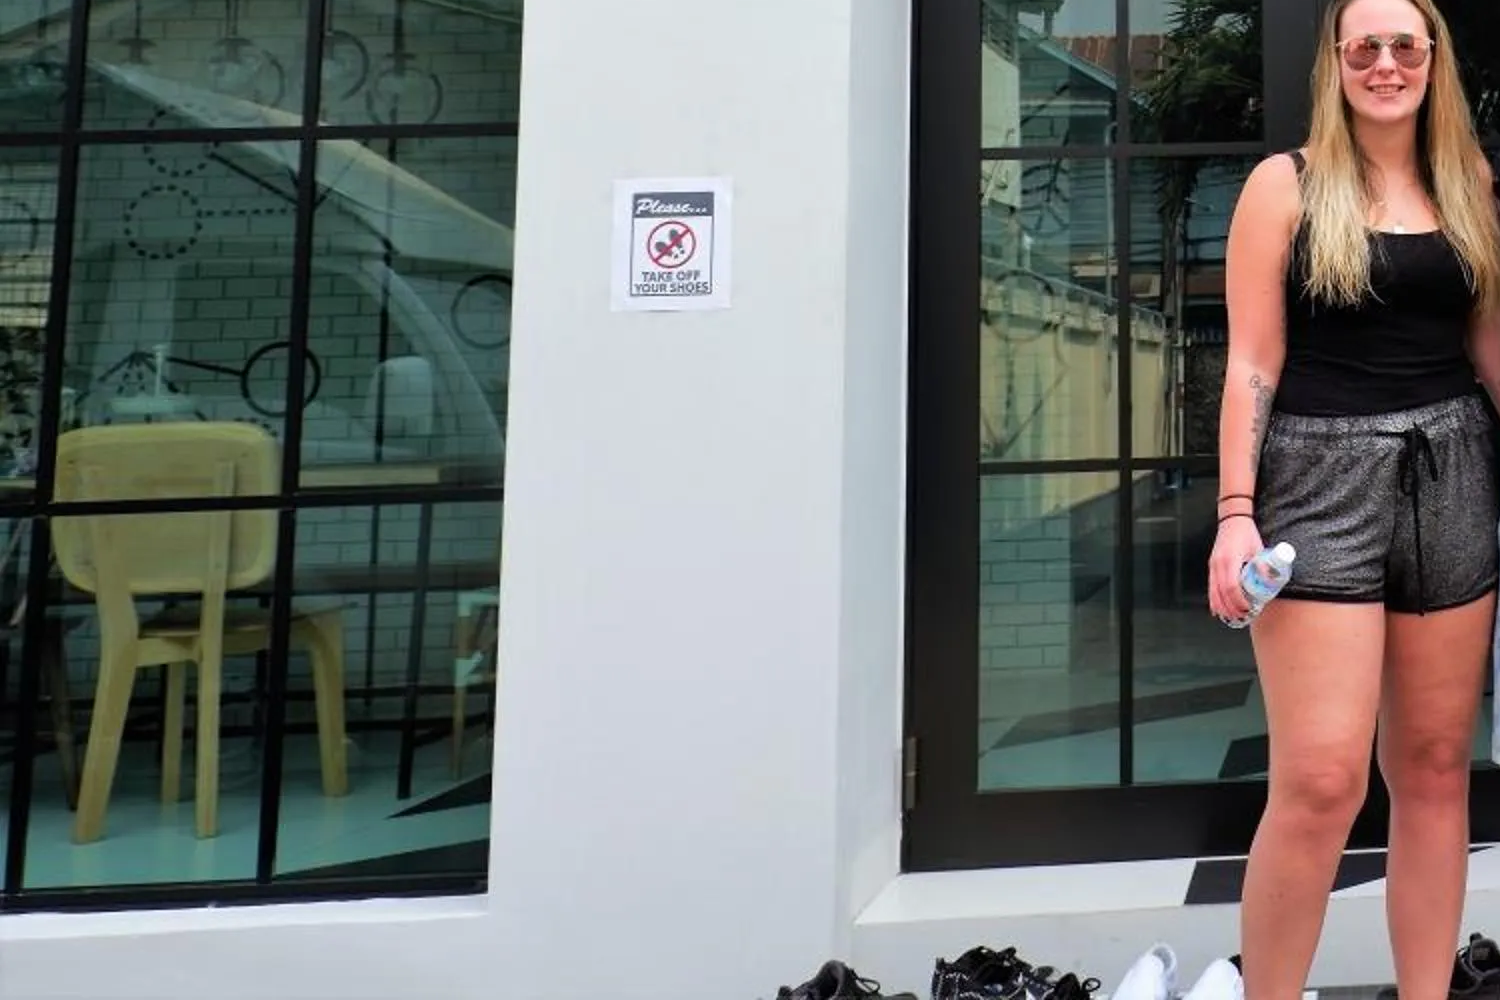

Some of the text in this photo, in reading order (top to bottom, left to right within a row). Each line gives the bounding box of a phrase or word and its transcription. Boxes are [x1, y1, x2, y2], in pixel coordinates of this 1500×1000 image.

[641, 270, 701, 282] TAKE OFF
[634, 281, 709, 293] YOUR SHOES
